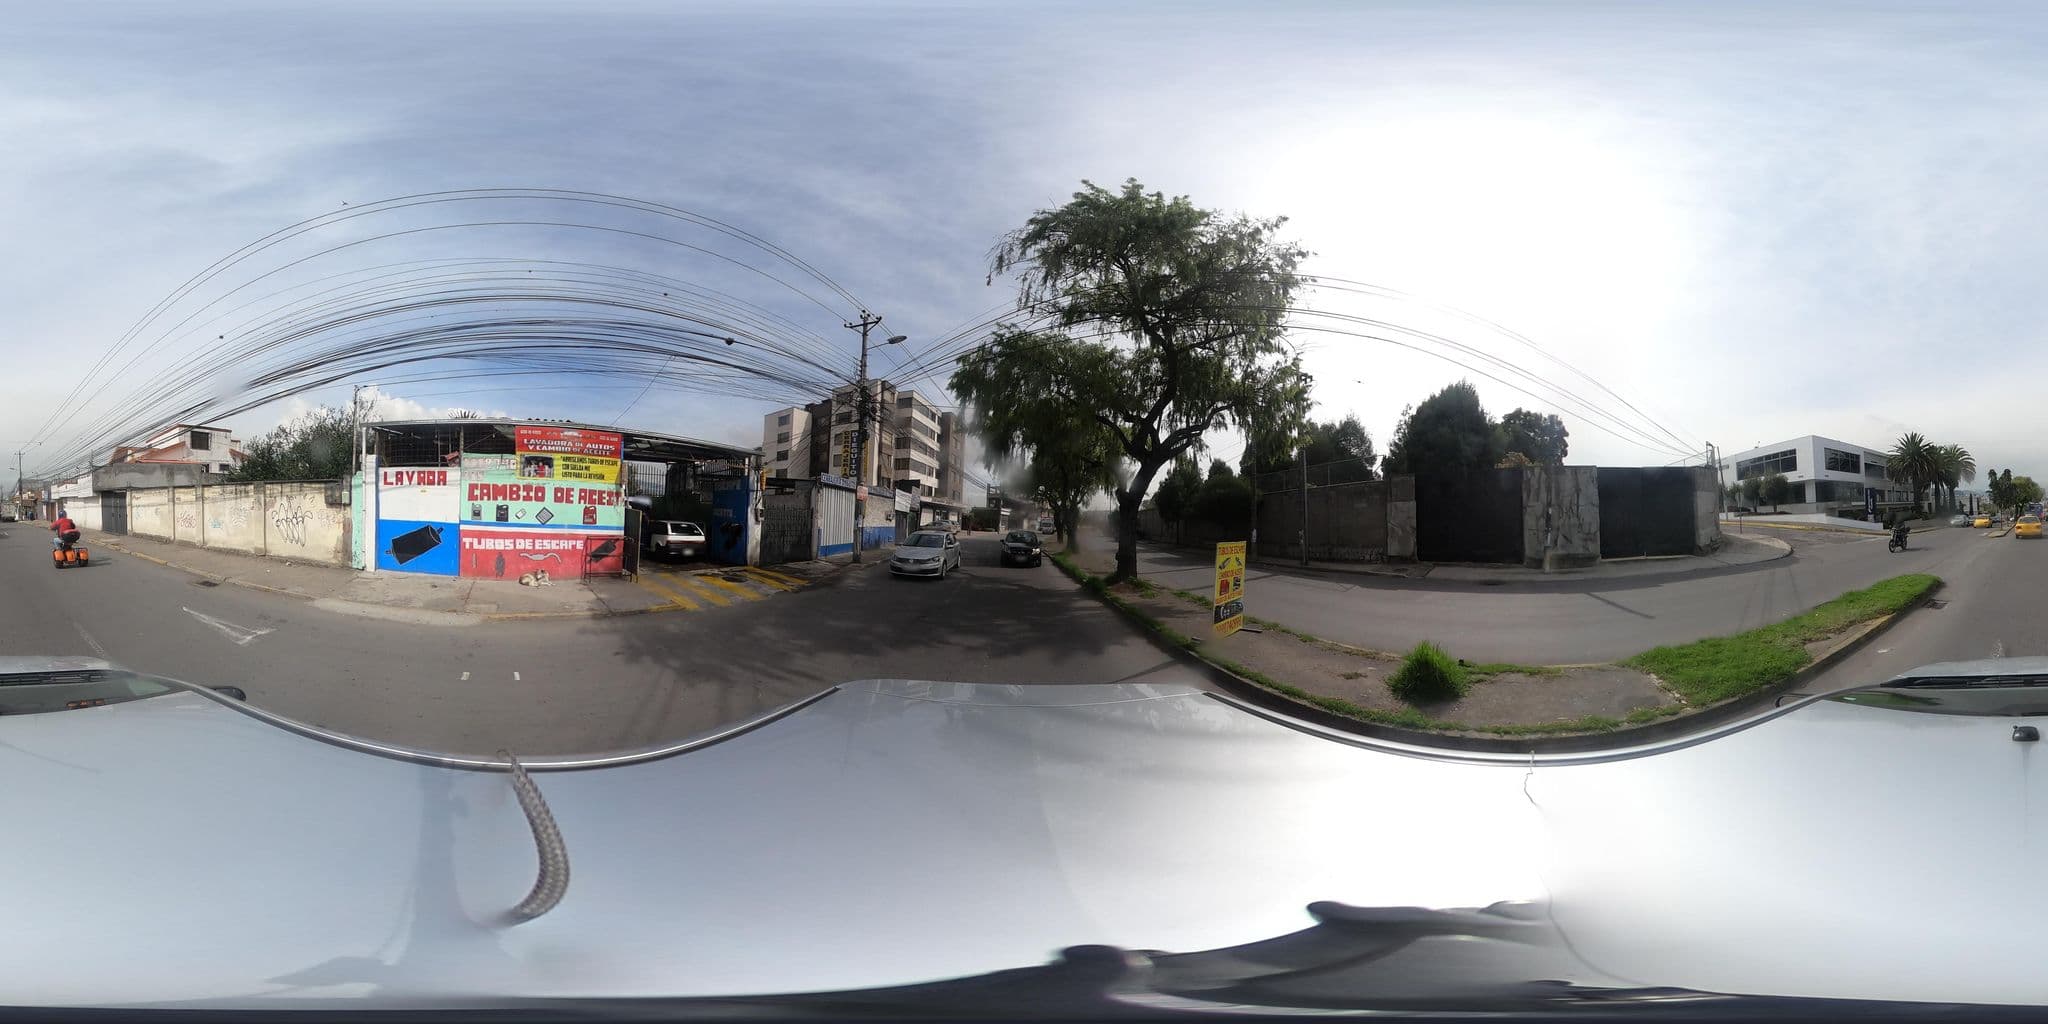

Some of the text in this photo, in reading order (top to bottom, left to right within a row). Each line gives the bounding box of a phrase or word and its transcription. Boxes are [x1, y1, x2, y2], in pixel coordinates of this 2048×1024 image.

[523, 438, 573, 447] LAVADORA
[536, 445, 571, 453] CAMBIO
[850, 431, 858, 476] DIEGUITO
[467, 482, 546, 502] CAMBIO
[553, 486, 575, 504] DE
[463, 537, 585, 551] TUBOS DE ESCAPE
